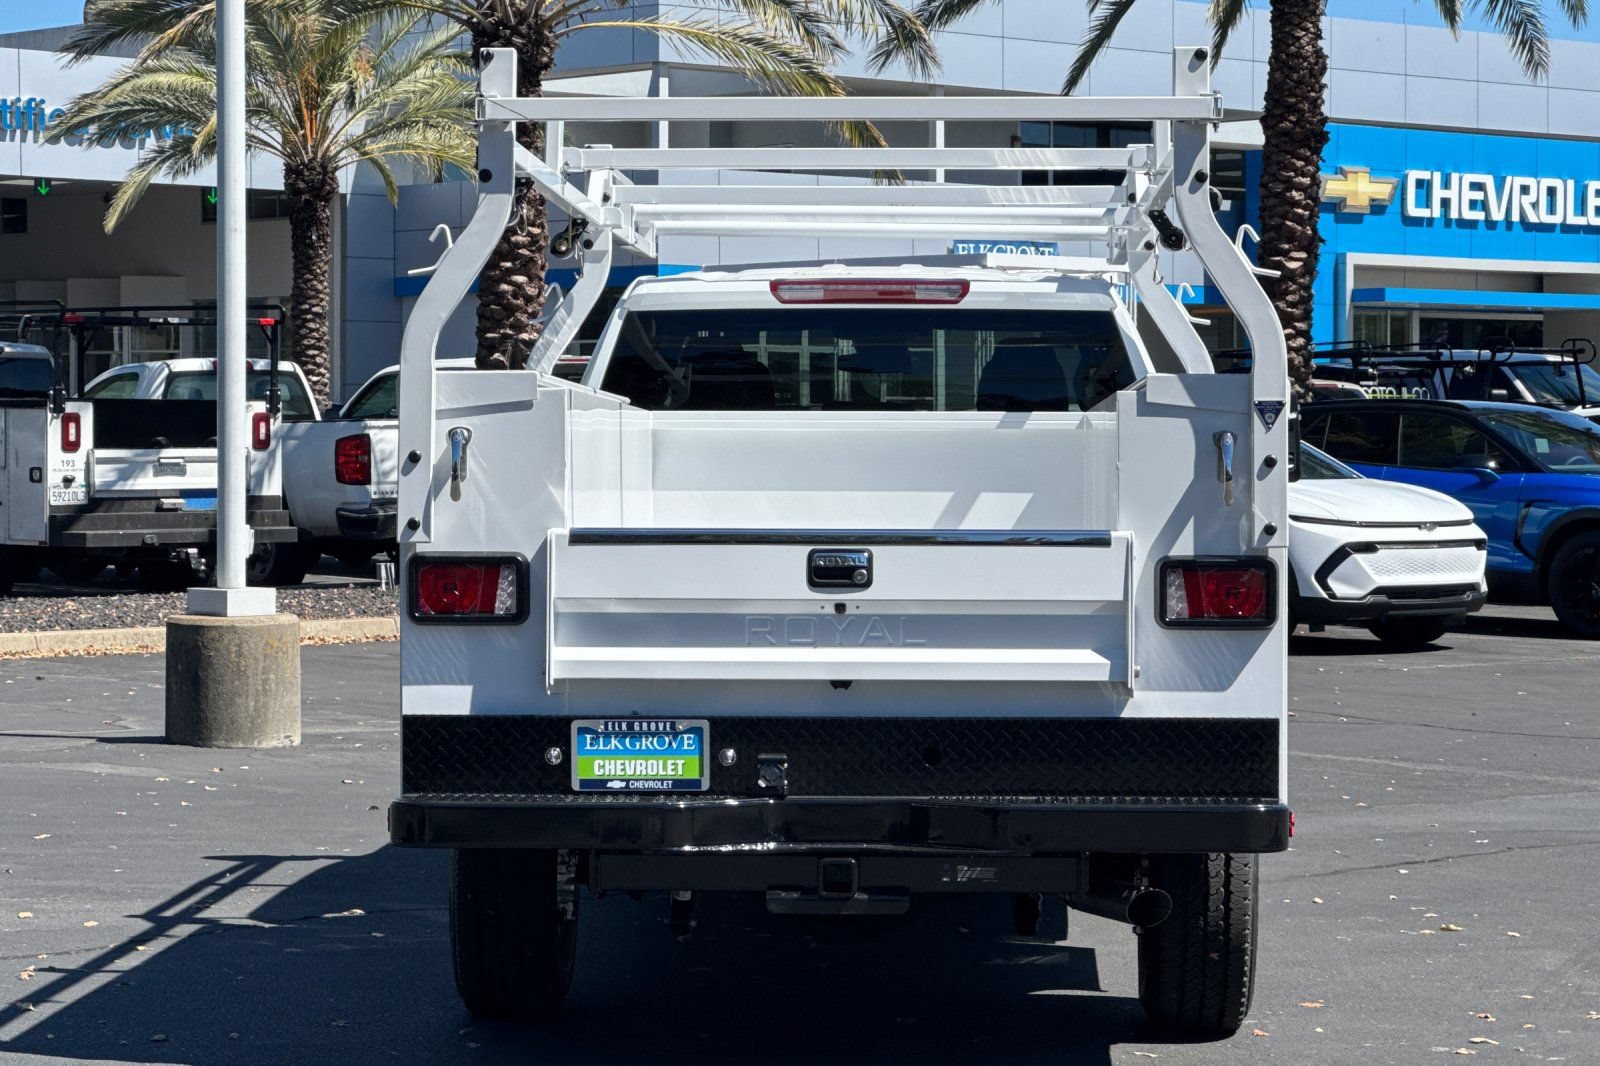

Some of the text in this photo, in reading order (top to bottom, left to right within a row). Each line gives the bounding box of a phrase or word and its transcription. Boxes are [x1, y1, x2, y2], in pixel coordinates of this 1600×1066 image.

[61, 459, 75, 468] 193
[815, 555, 867, 567] ROYAL
[745, 615, 927, 646] ROYAL
[608, 722, 671, 731] ELK GROVE
[593, 759, 686, 776] CHEVROLET
[629, 780, 673, 789] CHEVROLET
